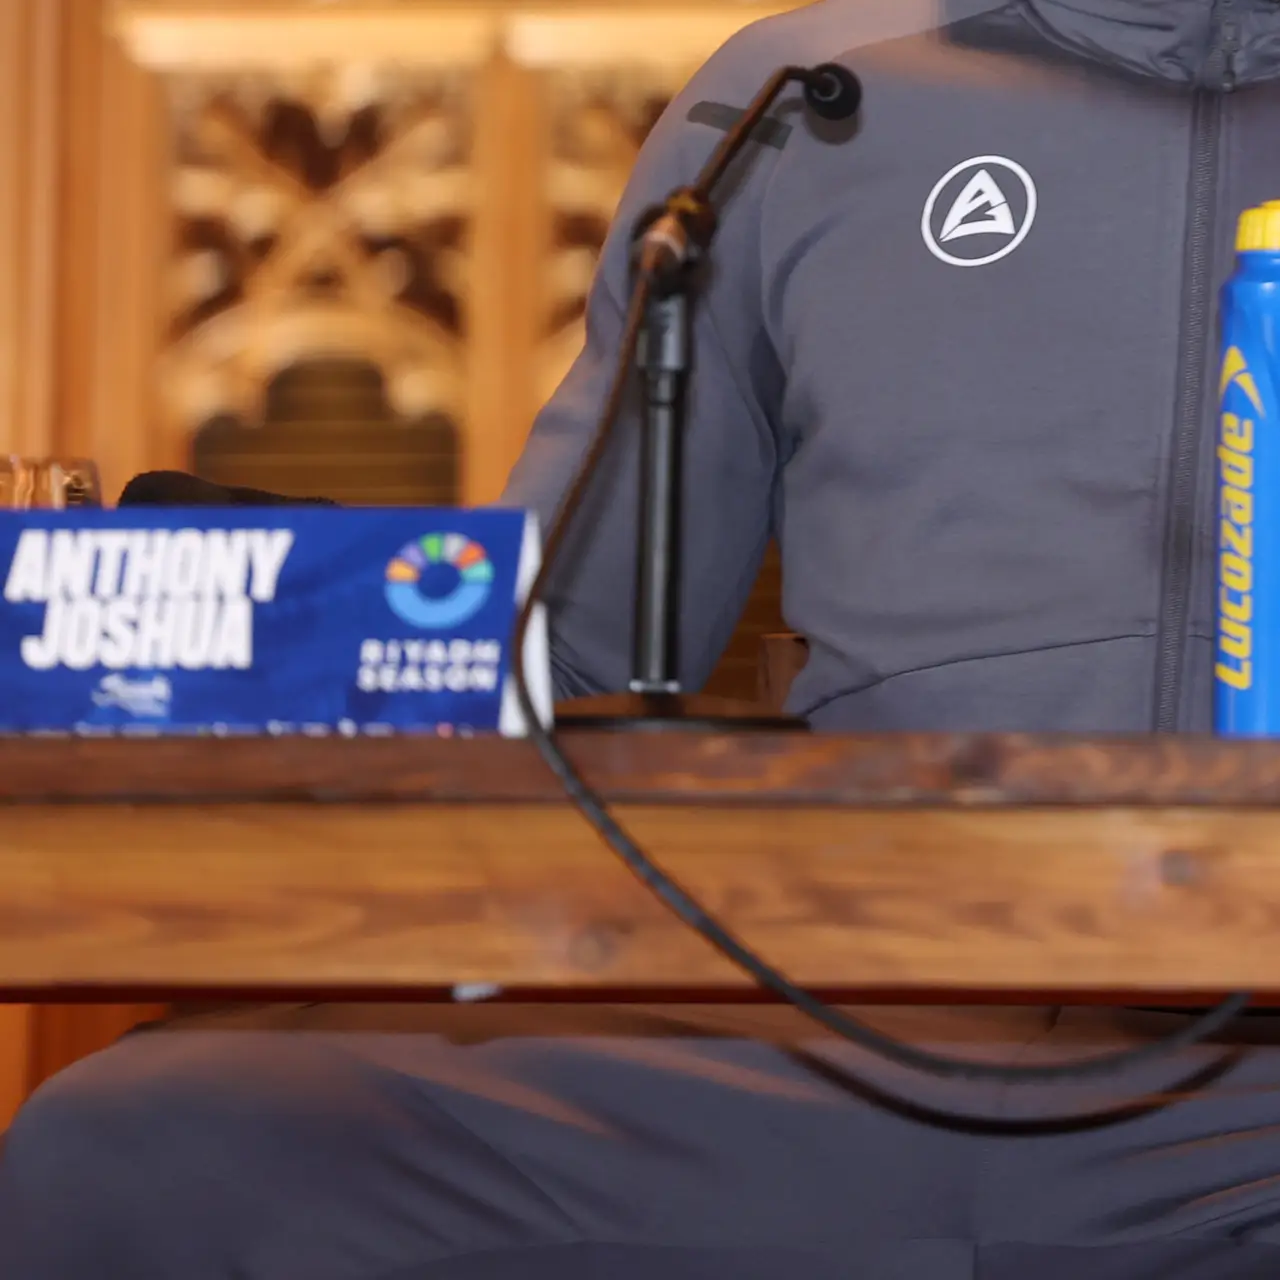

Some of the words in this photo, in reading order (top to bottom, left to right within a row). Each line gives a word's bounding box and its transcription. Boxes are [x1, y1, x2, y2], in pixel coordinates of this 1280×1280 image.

[4, 528, 295, 602] ANTHONY
[20, 595, 253, 670] JOSHUA
[360, 638, 501, 663] RIYADH
[357, 663, 498, 692] SEASON
